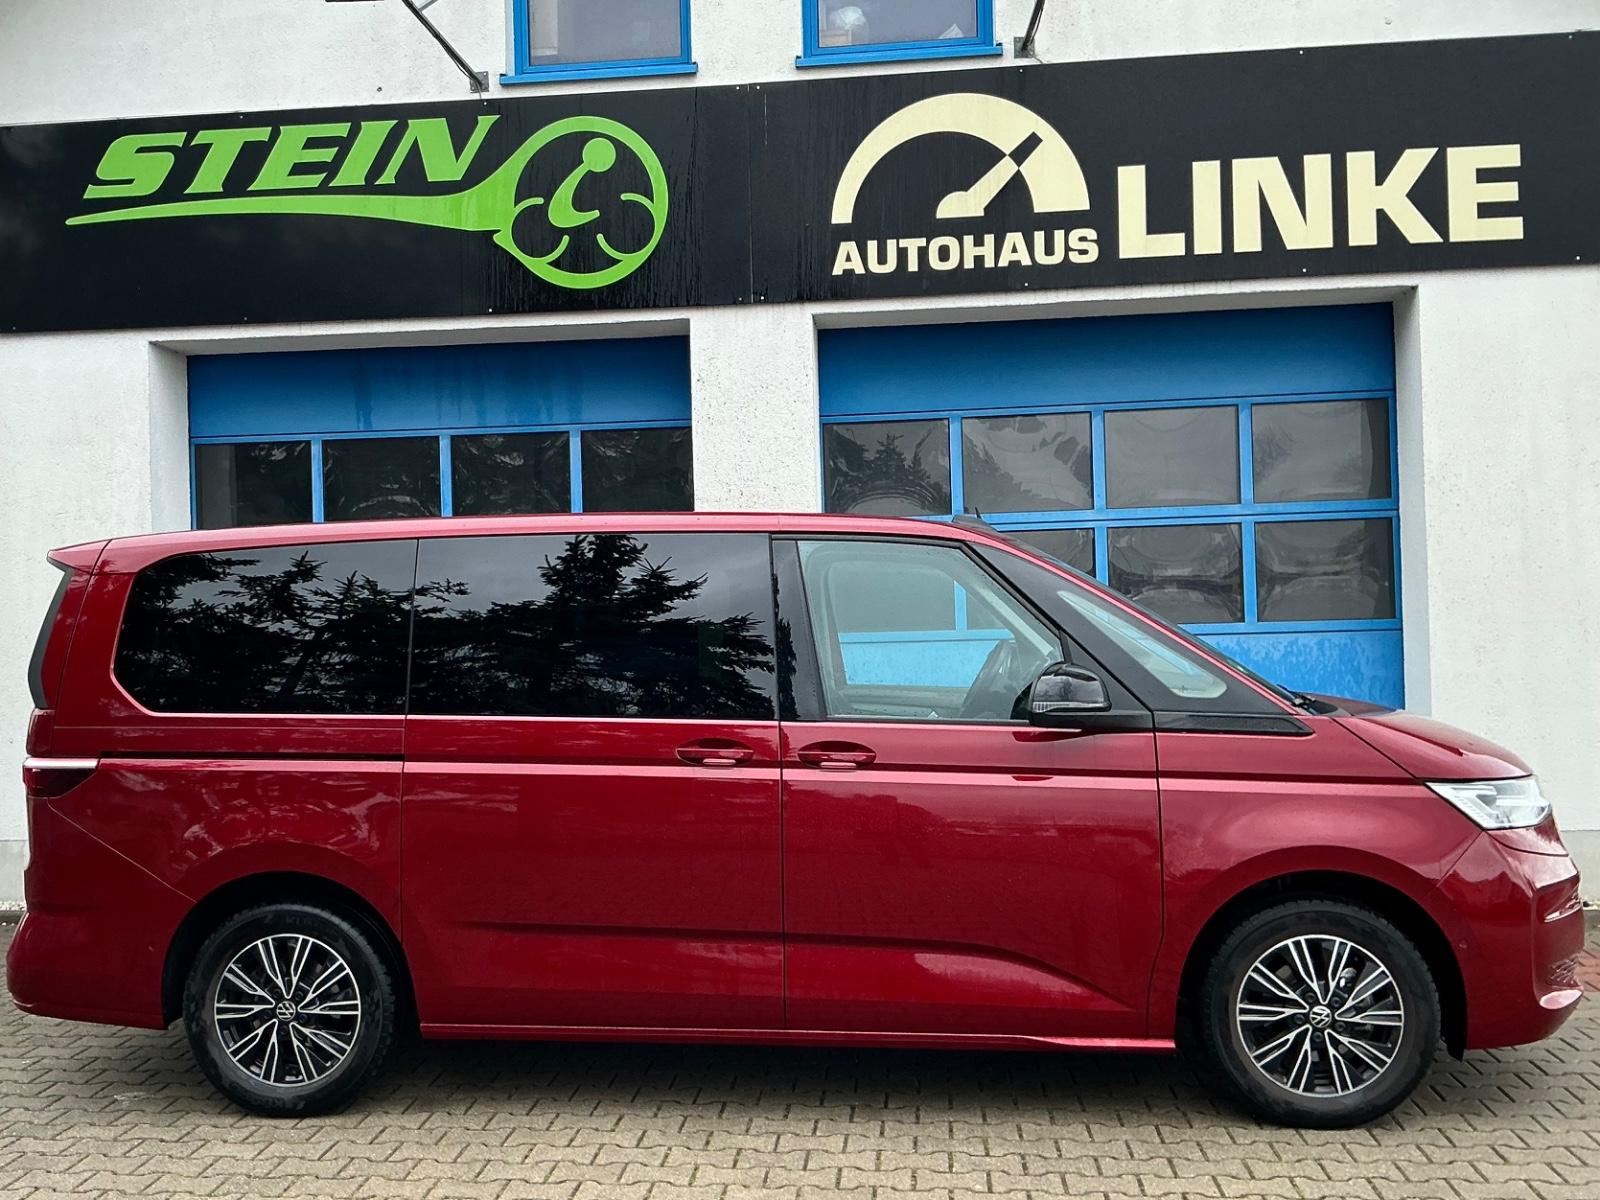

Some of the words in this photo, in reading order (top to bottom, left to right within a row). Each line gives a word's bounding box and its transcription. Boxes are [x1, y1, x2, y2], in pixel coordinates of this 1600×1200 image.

[83, 115, 498, 200] STEIN
[831, 227, 1100, 277] AUTOHAUS
[1116, 143, 1525, 260] LINKE
